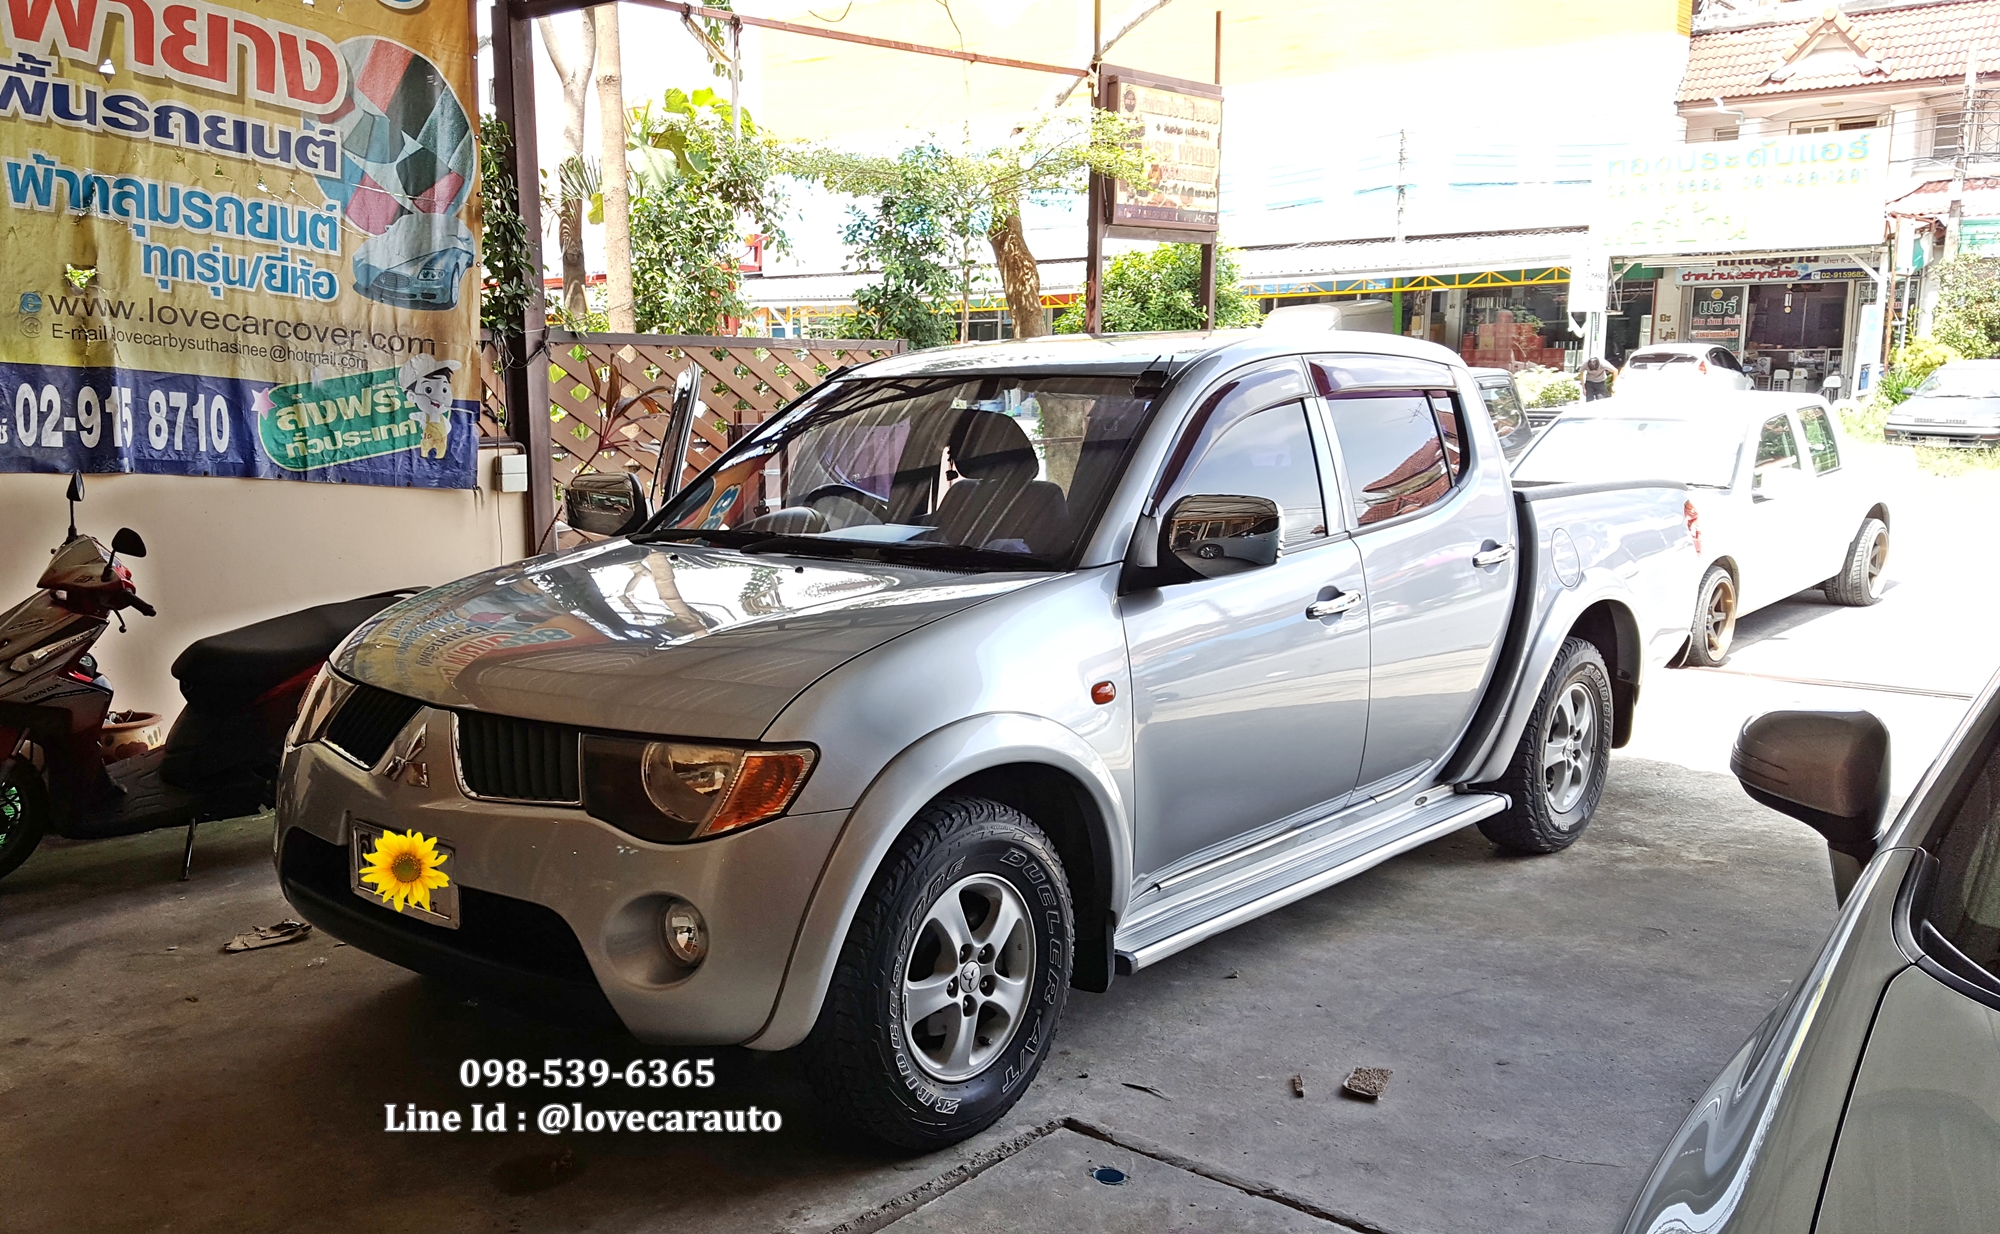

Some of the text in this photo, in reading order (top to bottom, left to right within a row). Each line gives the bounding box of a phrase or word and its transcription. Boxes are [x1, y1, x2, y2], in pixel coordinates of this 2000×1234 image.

[7, 153, 338, 252] ผ้าคลุมรถยนต์
[143, 245, 337, 301] ทุกรุ่น/ยี่ห้อ
[48, 295, 435, 356] www.lovecarcover.com
[147, 389, 230, 453] 8710
[22, 683, 62, 701] HONDA
[999, 846, 1062, 1005] DUELER
